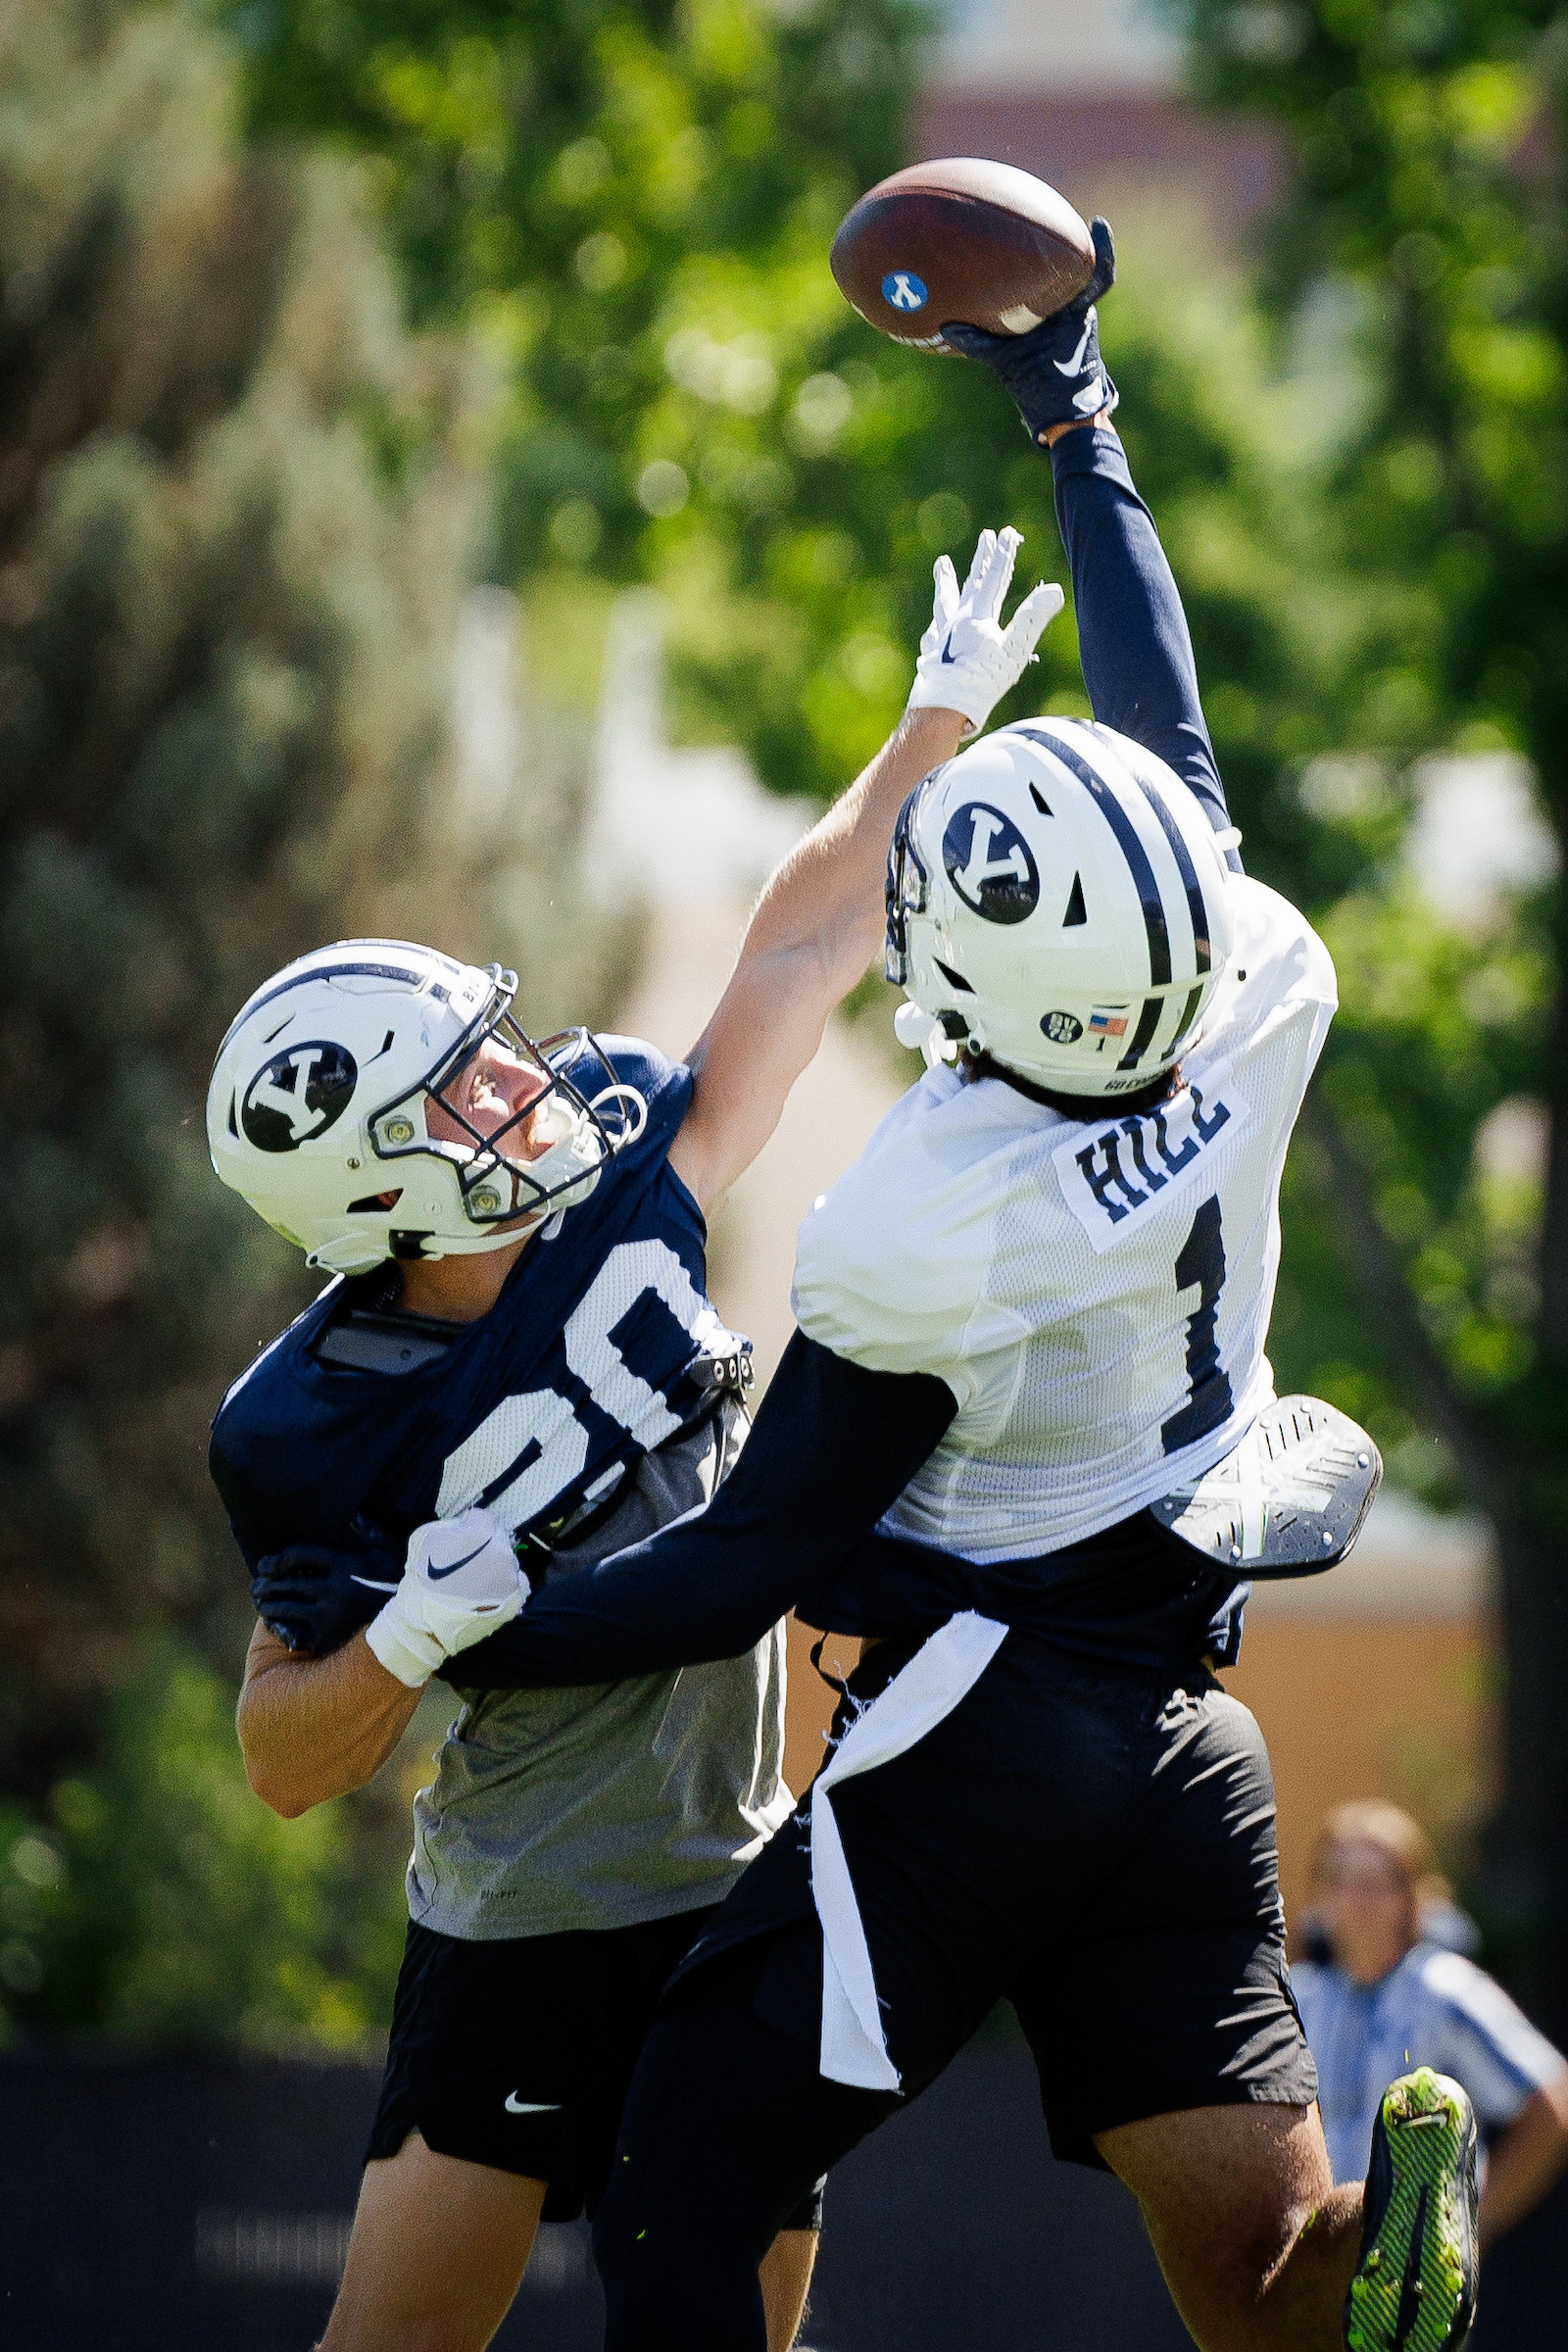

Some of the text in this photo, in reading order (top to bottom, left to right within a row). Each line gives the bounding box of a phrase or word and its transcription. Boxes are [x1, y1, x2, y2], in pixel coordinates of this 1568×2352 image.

[953, 806, 1030, 905] Y
[247, 1047, 327, 1142] Y
[1076, 1085, 1232, 1225] HILL
[1161, 1193, 1236, 1457] 1
